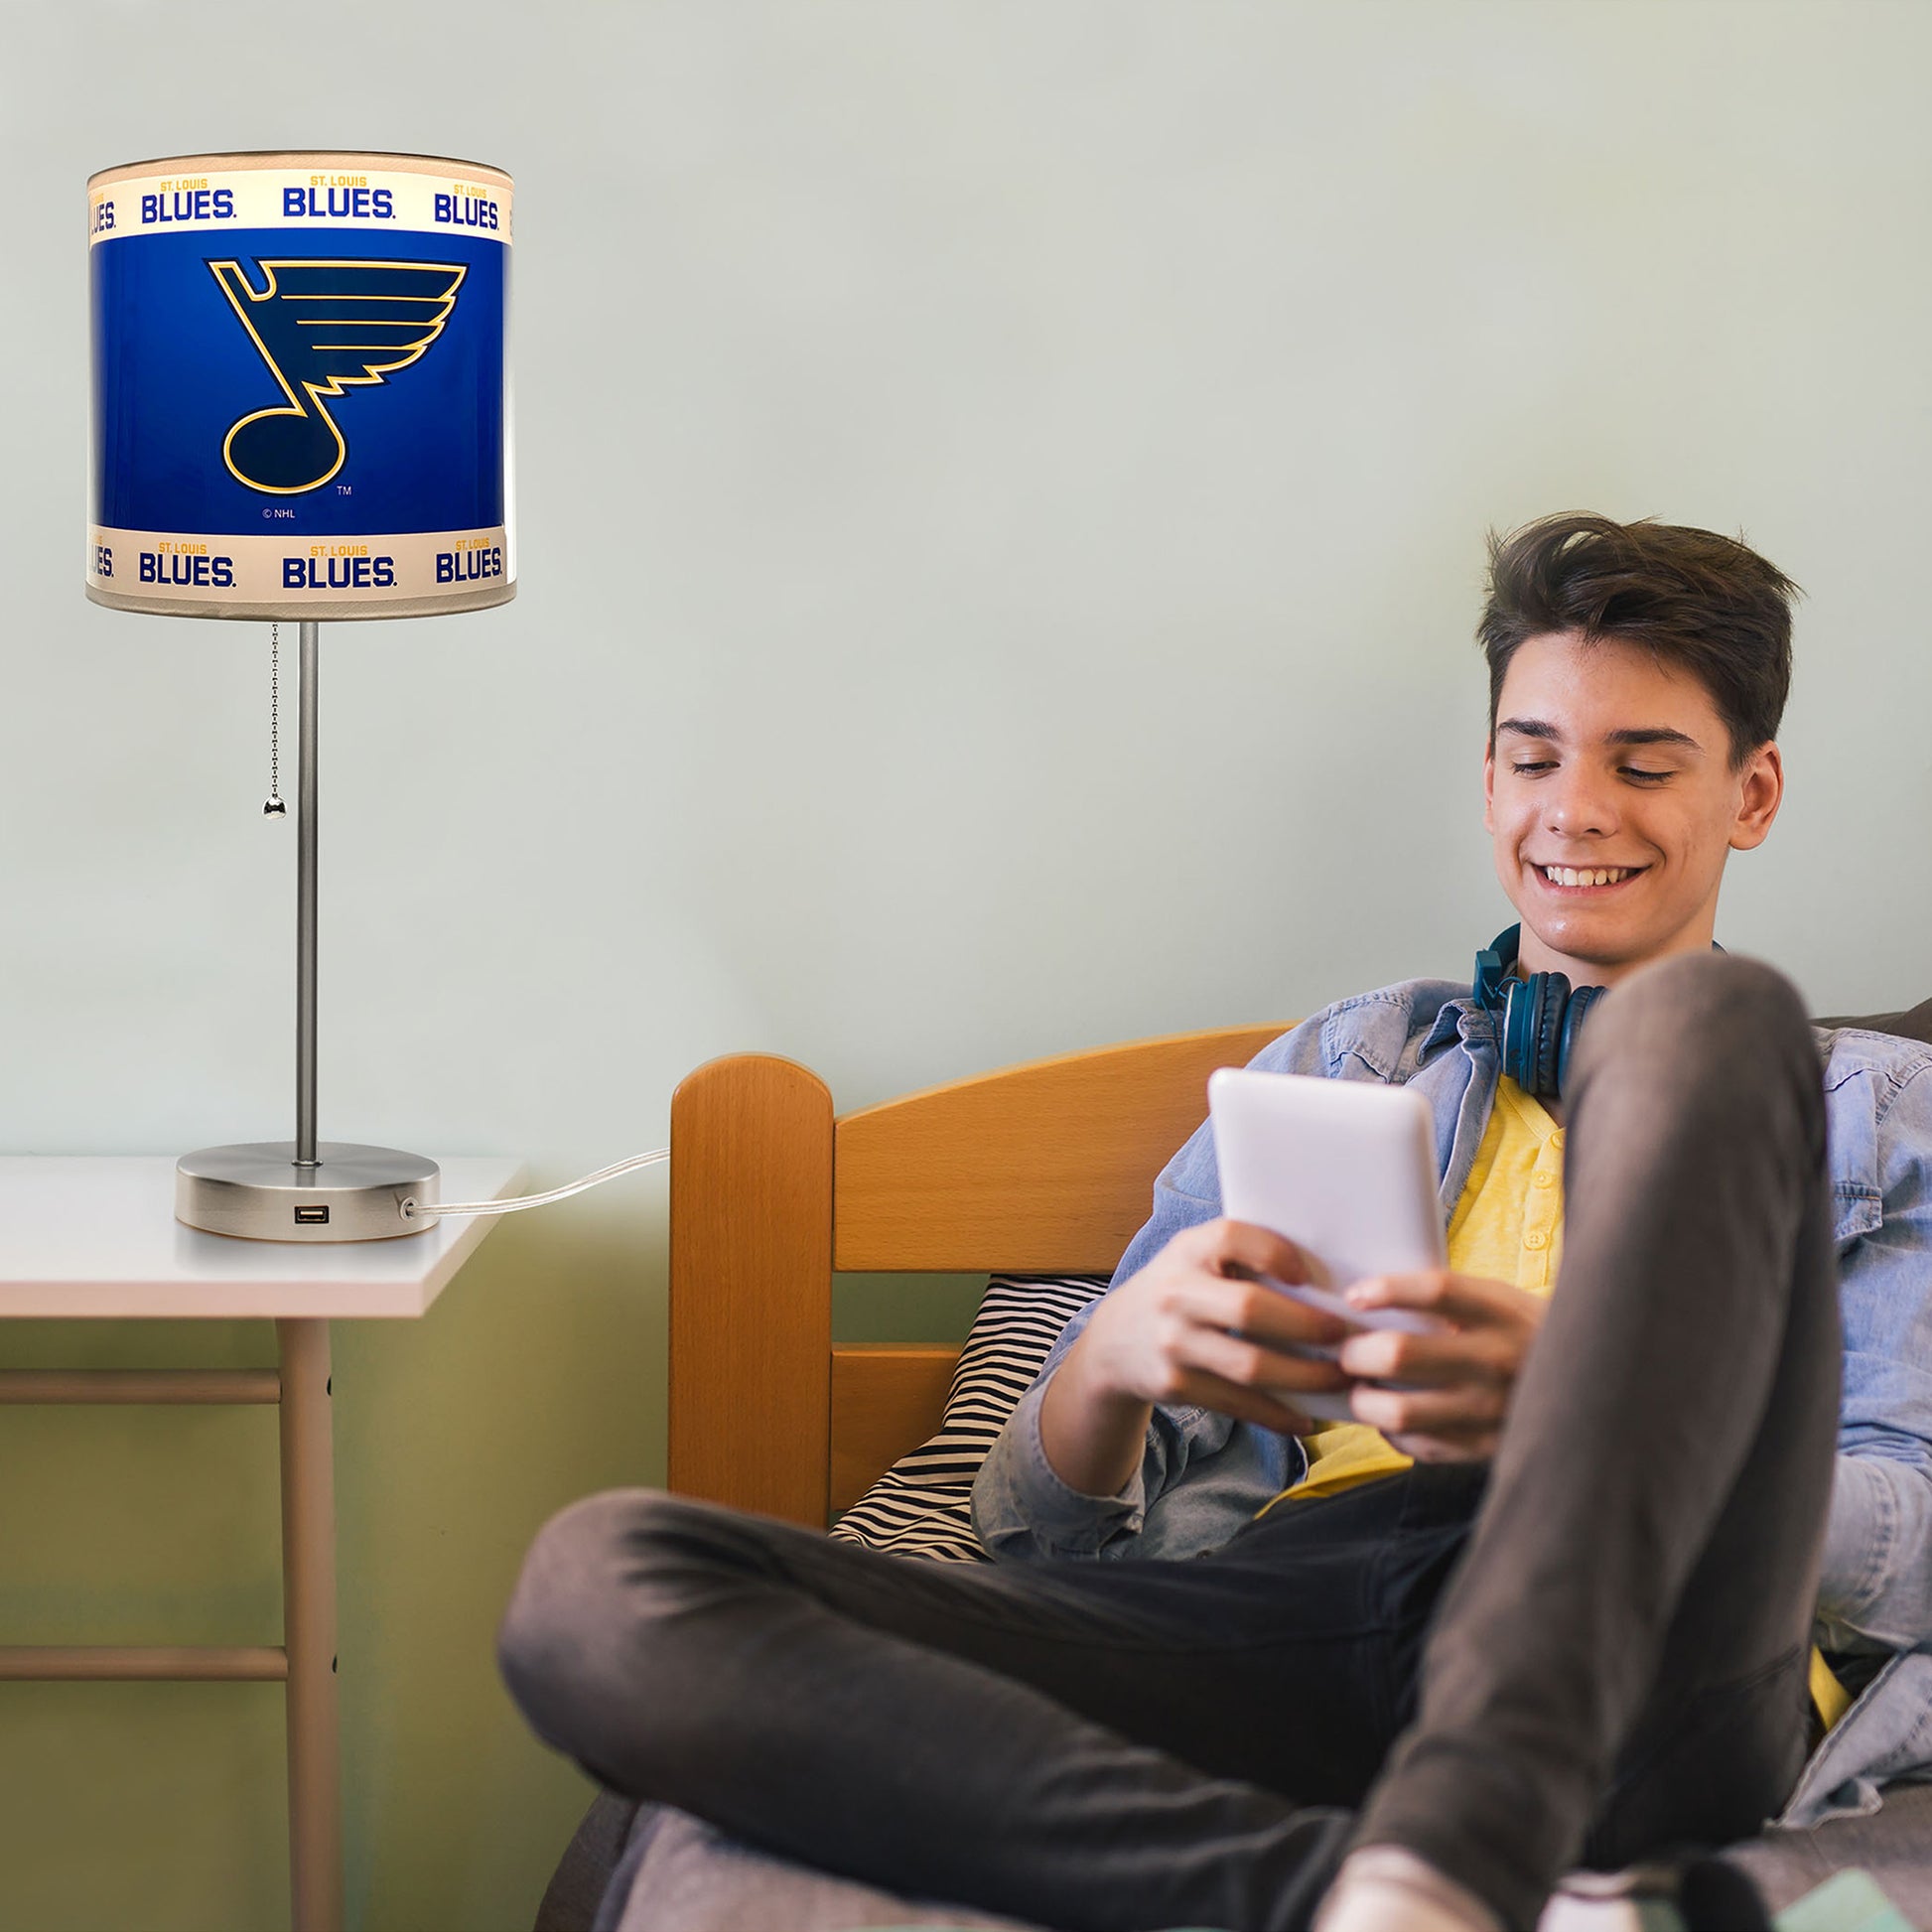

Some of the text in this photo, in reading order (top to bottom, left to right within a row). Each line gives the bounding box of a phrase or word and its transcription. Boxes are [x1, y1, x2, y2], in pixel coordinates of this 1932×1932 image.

[176, 178, 208, 191] LOUIS
[310, 175, 367, 187] ST. LOUIS
[466, 185, 487, 199] LOUIS
[141, 189, 237, 224] BLUES.
[283, 187, 397, 219] BLUES.
[91, 201, 117, 235] UES.
[434, 193, 500, 231] BLUES.
[337, 485, 352, 496] TM
[274, 509, 296, 518] NHL
[175, 543, 207, 555] LOUIS
[469, 536, 490, 550] LOUIS
[310, 545, 368, 557] ST. LOUIS
[139, 552, 237, 588] BLUES.
[436, 546, 503, 584] BLUES.
[282, 556, 398, 589] BLUES.
